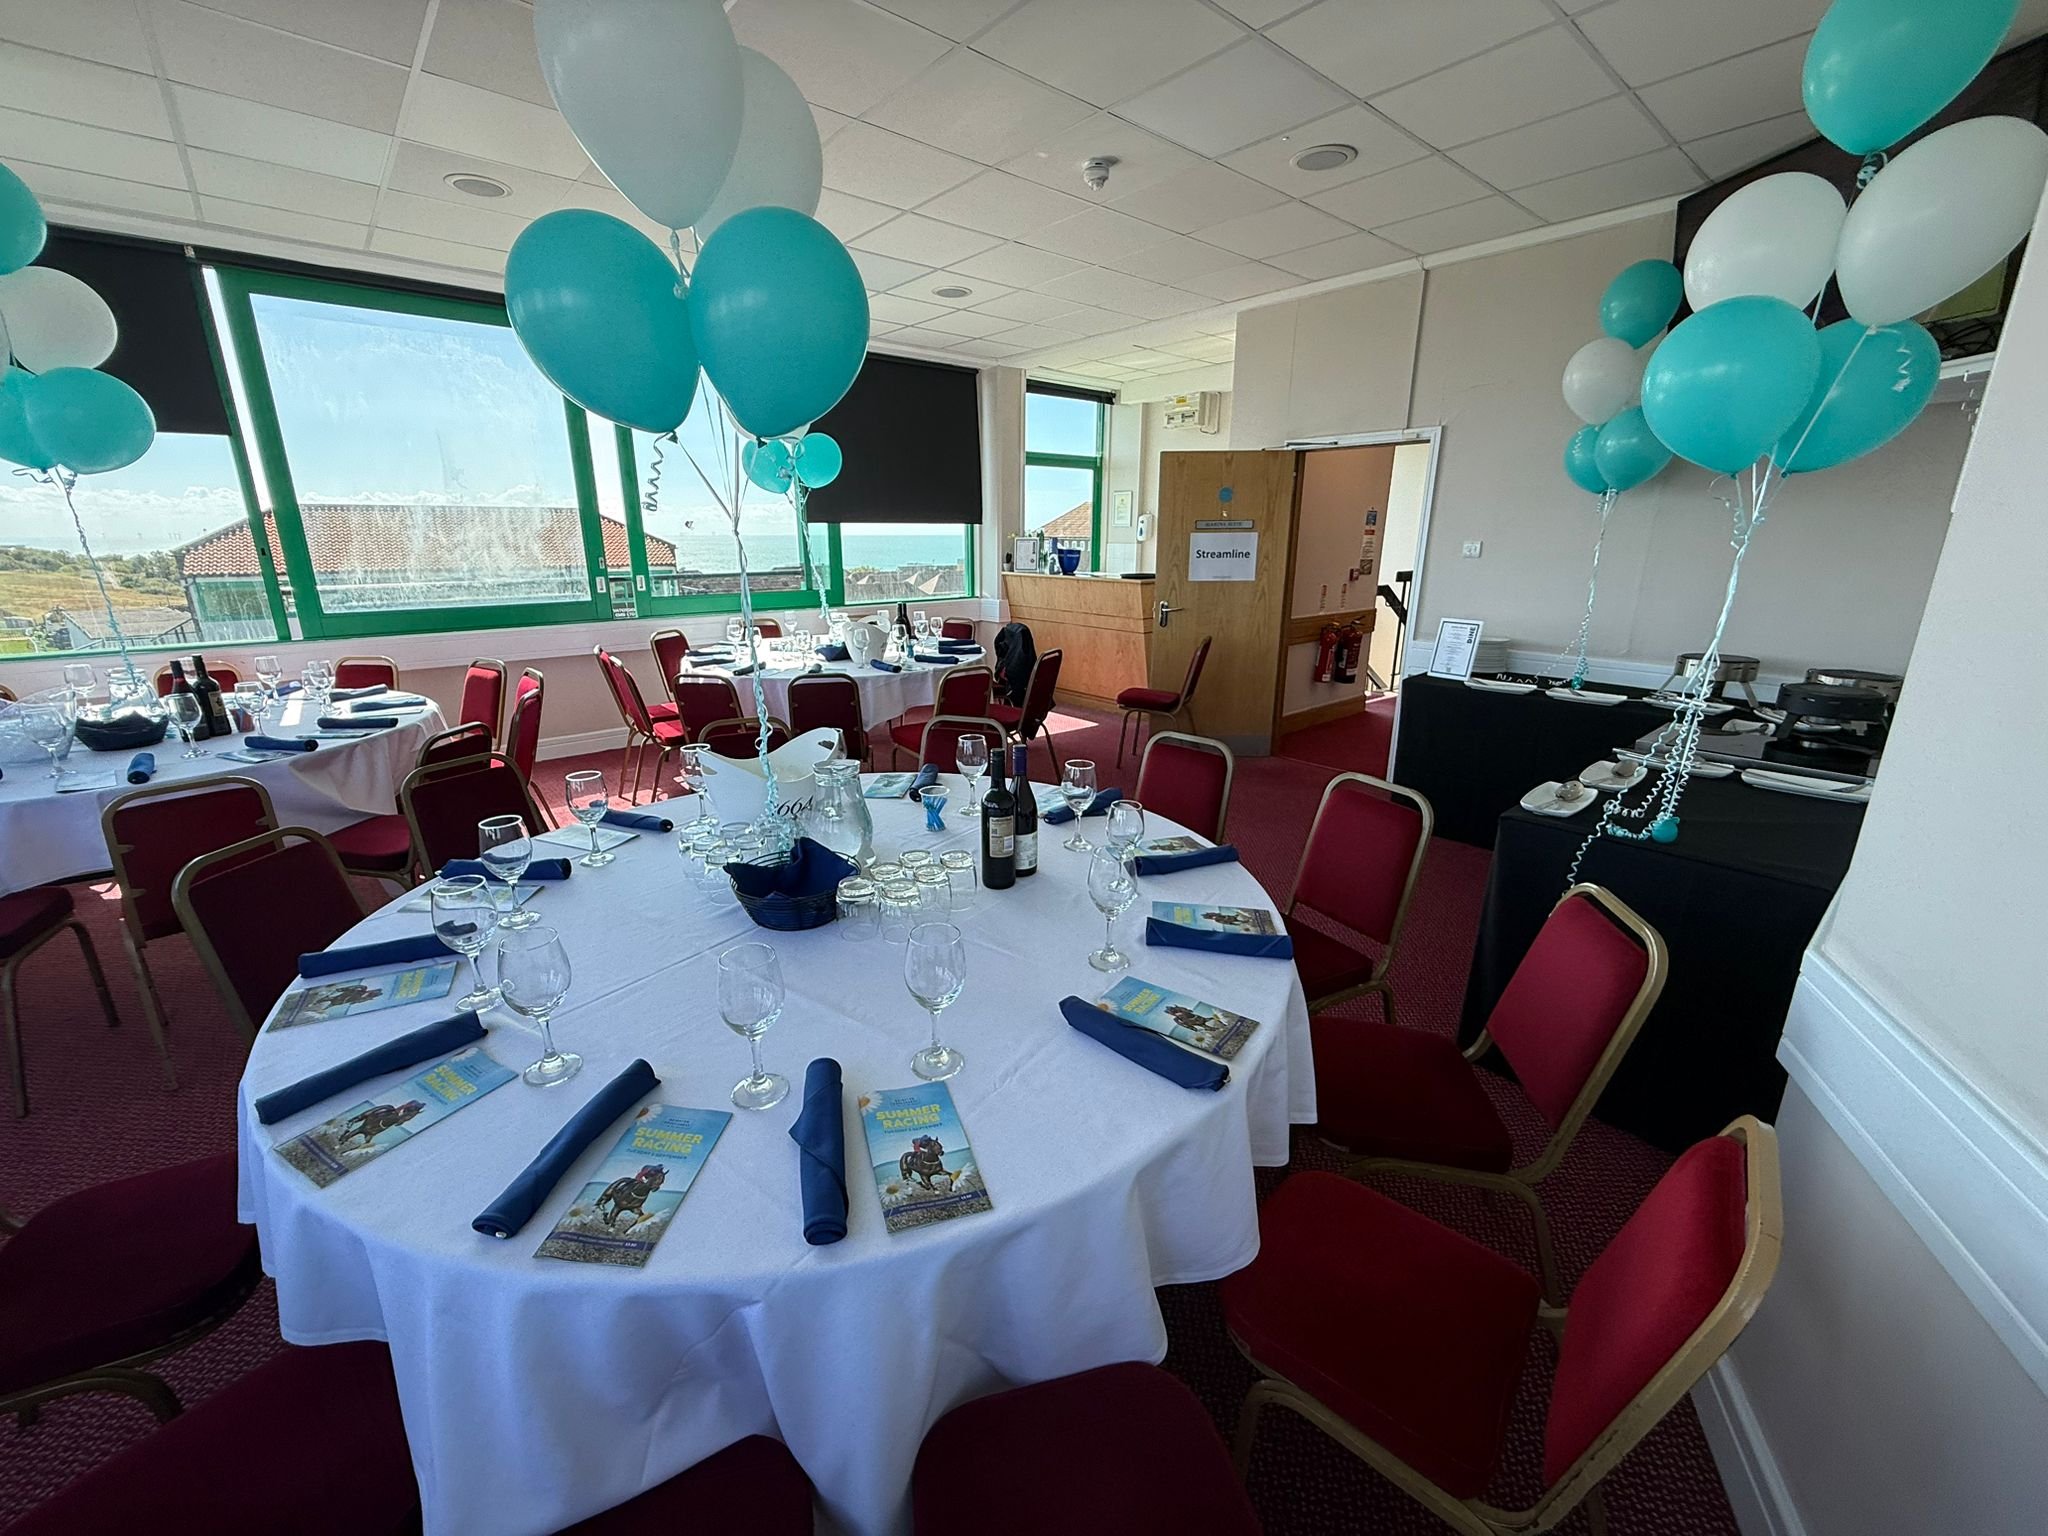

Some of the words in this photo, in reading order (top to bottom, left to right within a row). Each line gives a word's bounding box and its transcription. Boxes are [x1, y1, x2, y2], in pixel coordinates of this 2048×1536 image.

[1196, 549, 1251, 559] Streamline
[1466, 627, 1476, 644] DINE
[876, 1104, 942, 1121] SUMMER
[882, 1113, 941, 1130] RACING
[634, 1126, 704, 1145] SUMMER
[631, 1137, 694, 1156] RACING
